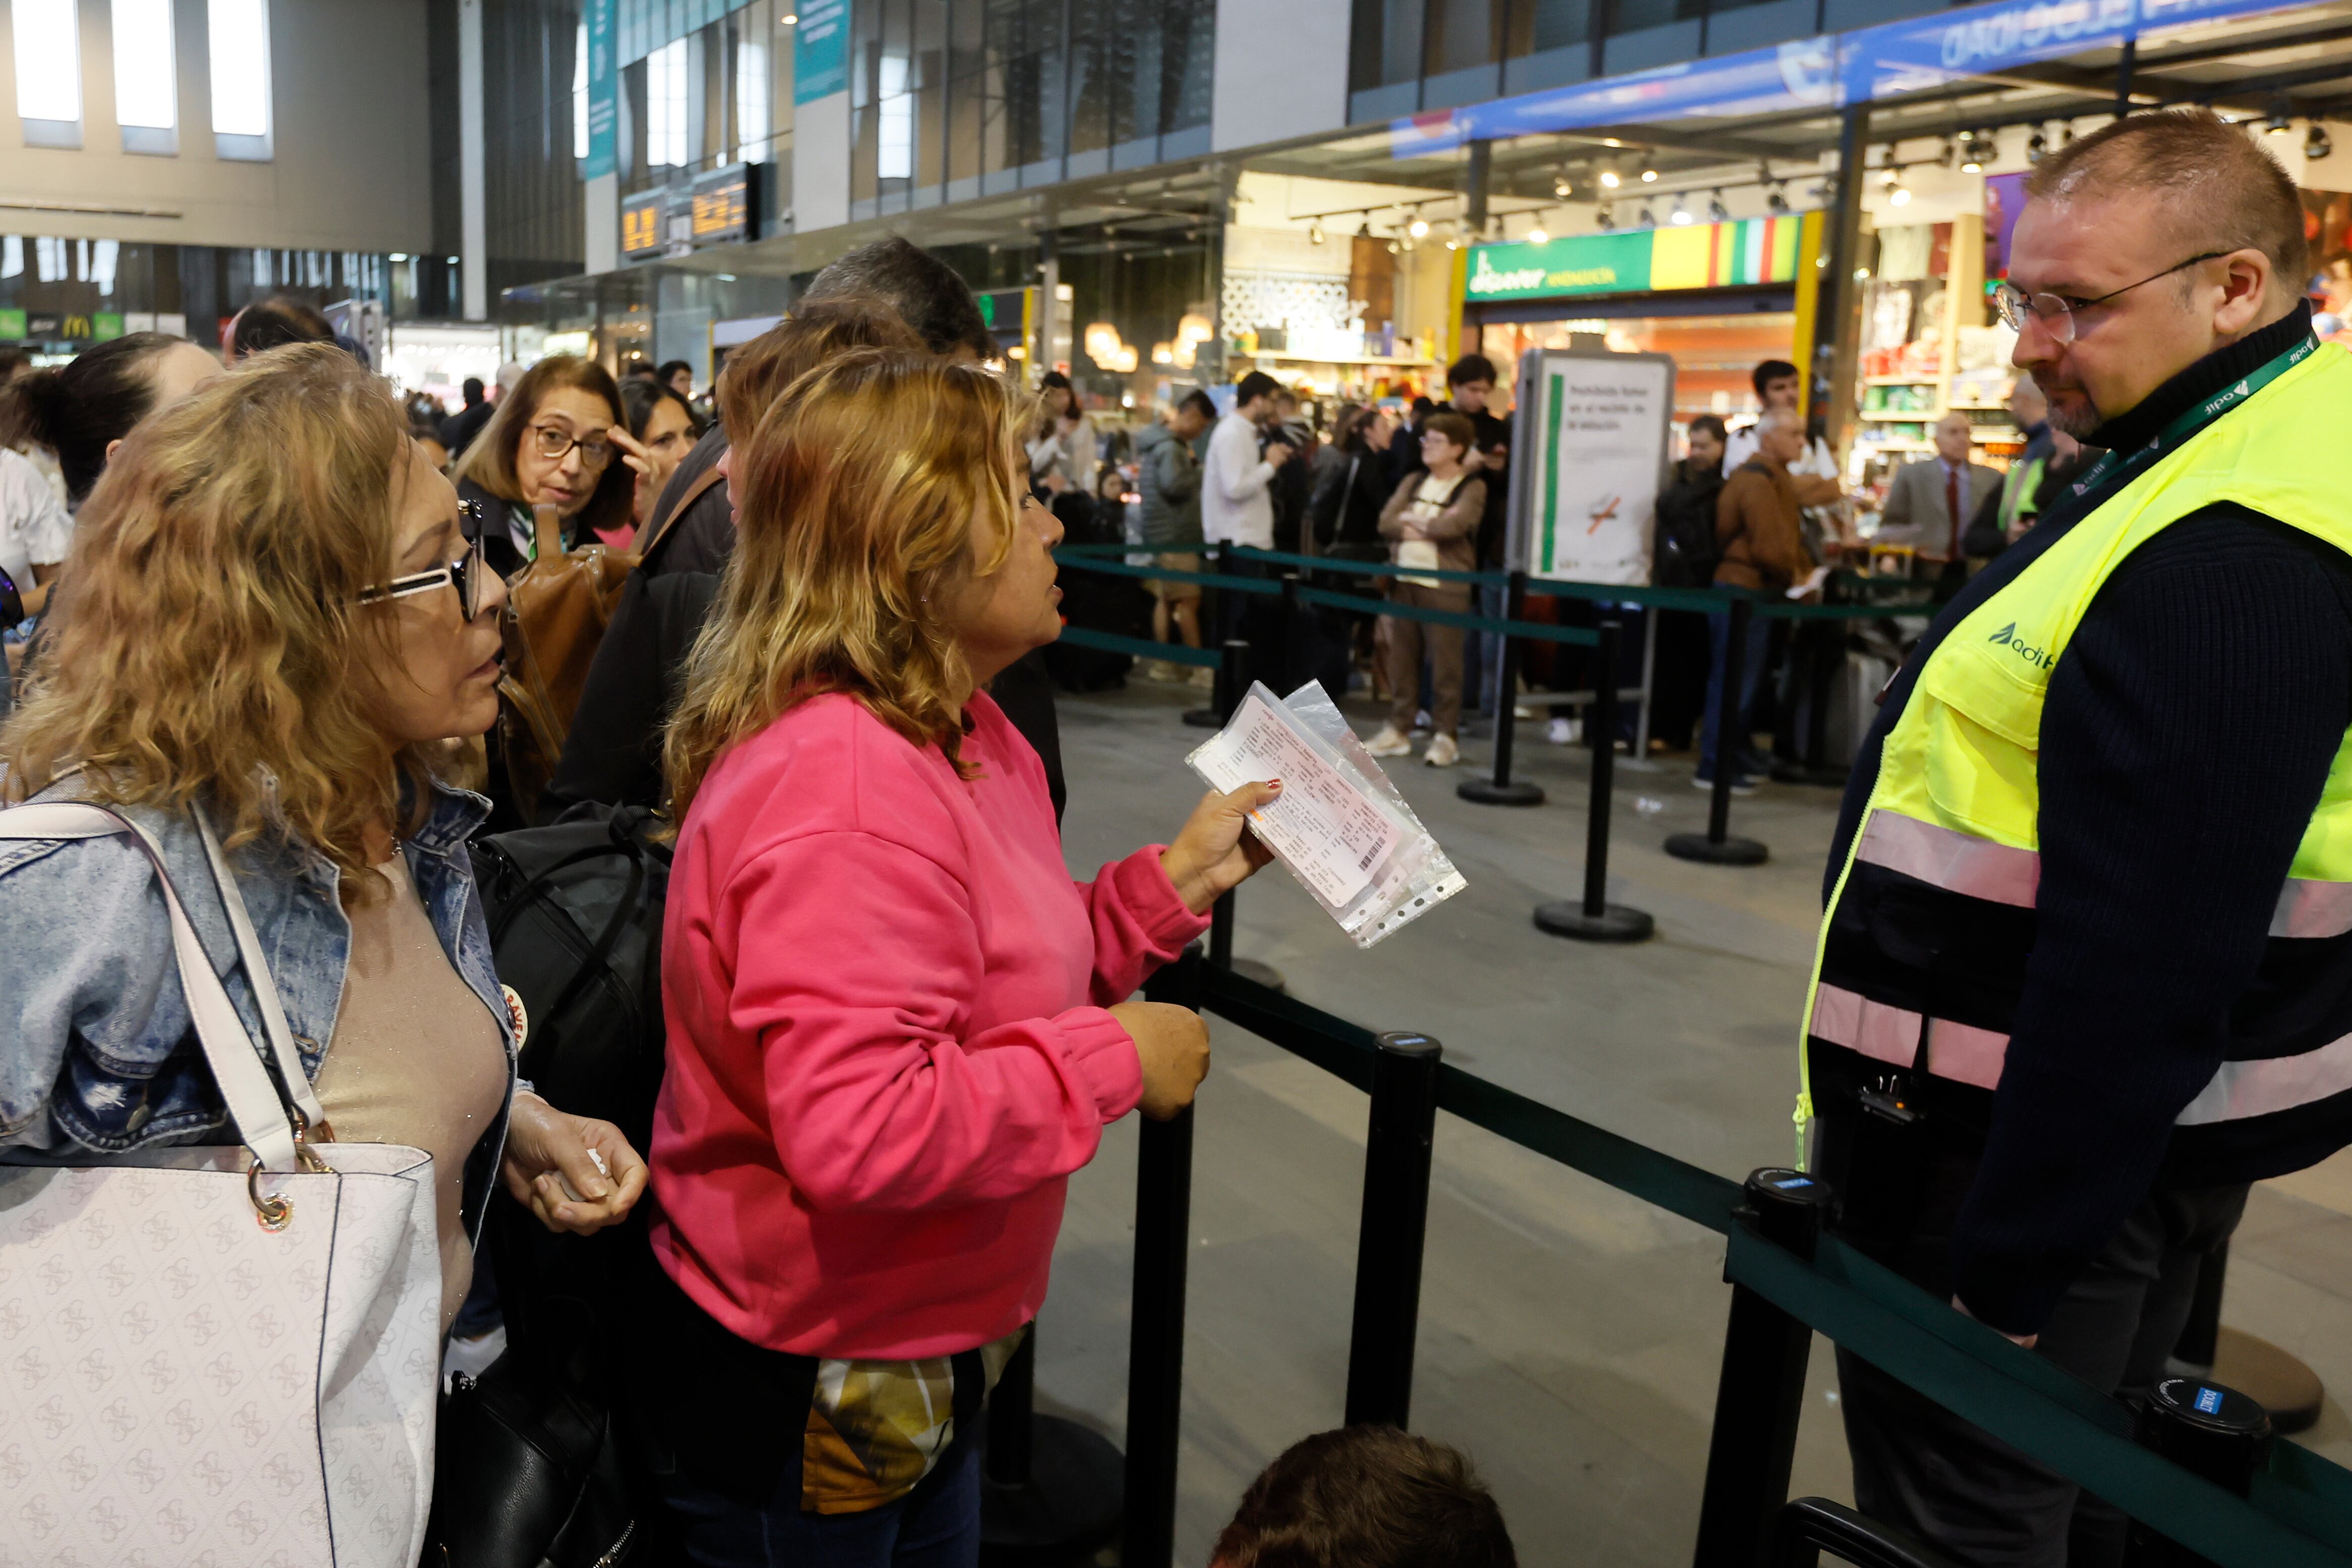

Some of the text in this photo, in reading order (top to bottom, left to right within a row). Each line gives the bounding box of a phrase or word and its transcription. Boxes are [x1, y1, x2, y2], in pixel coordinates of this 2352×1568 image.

[2289, 346, 2309, 365] adif
[2204, 394, 2236, 416] adif
[2012, 639, 2054, 669] adif
